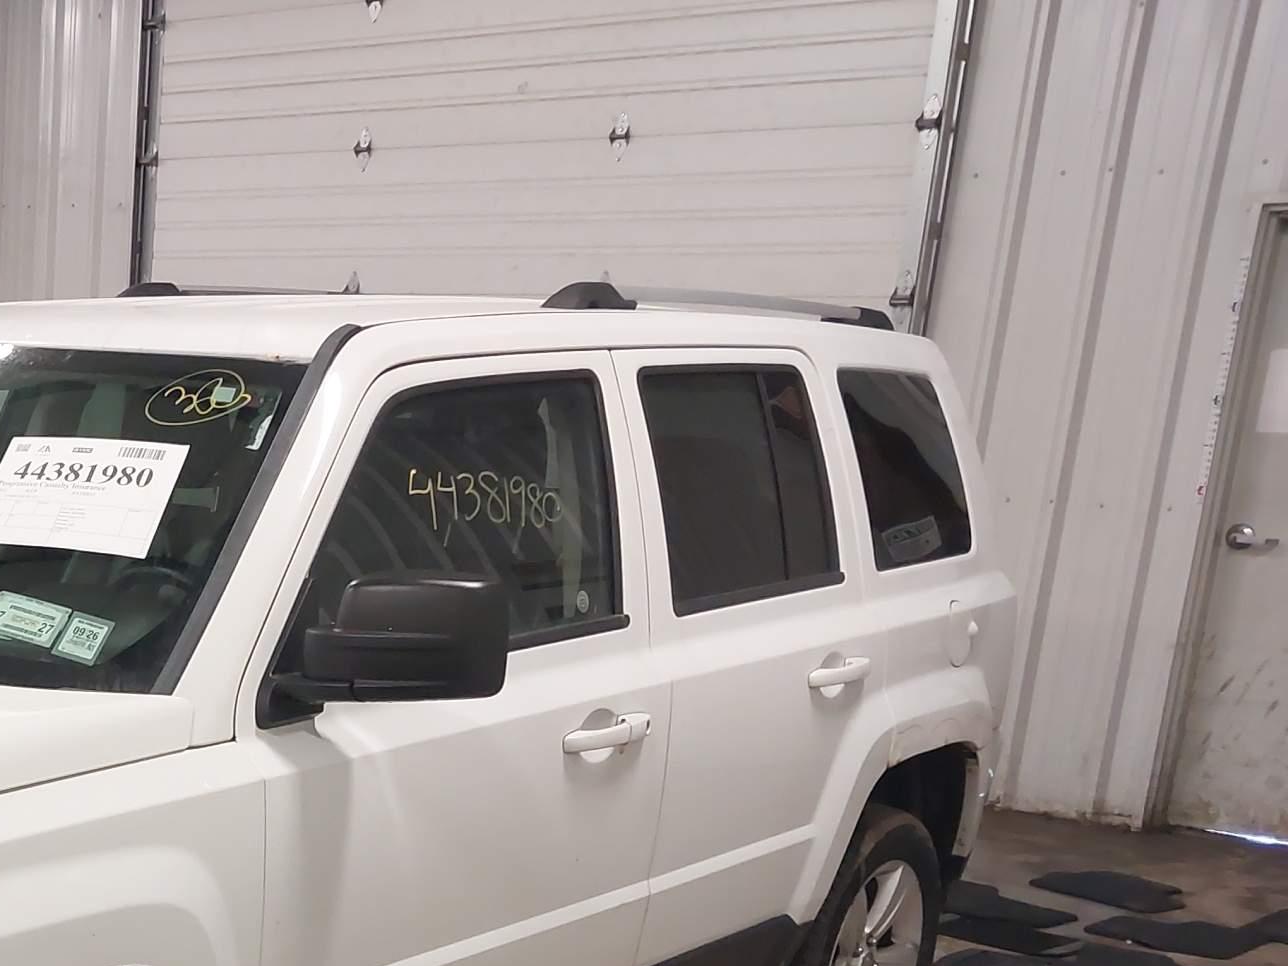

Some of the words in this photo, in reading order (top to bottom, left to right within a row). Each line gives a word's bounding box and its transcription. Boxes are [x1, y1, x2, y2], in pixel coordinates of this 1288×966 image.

[14, 460, 154, 488] 44381980
[408, 469, 561, 530] 44381980
[38, 622, 55, 635] 27
